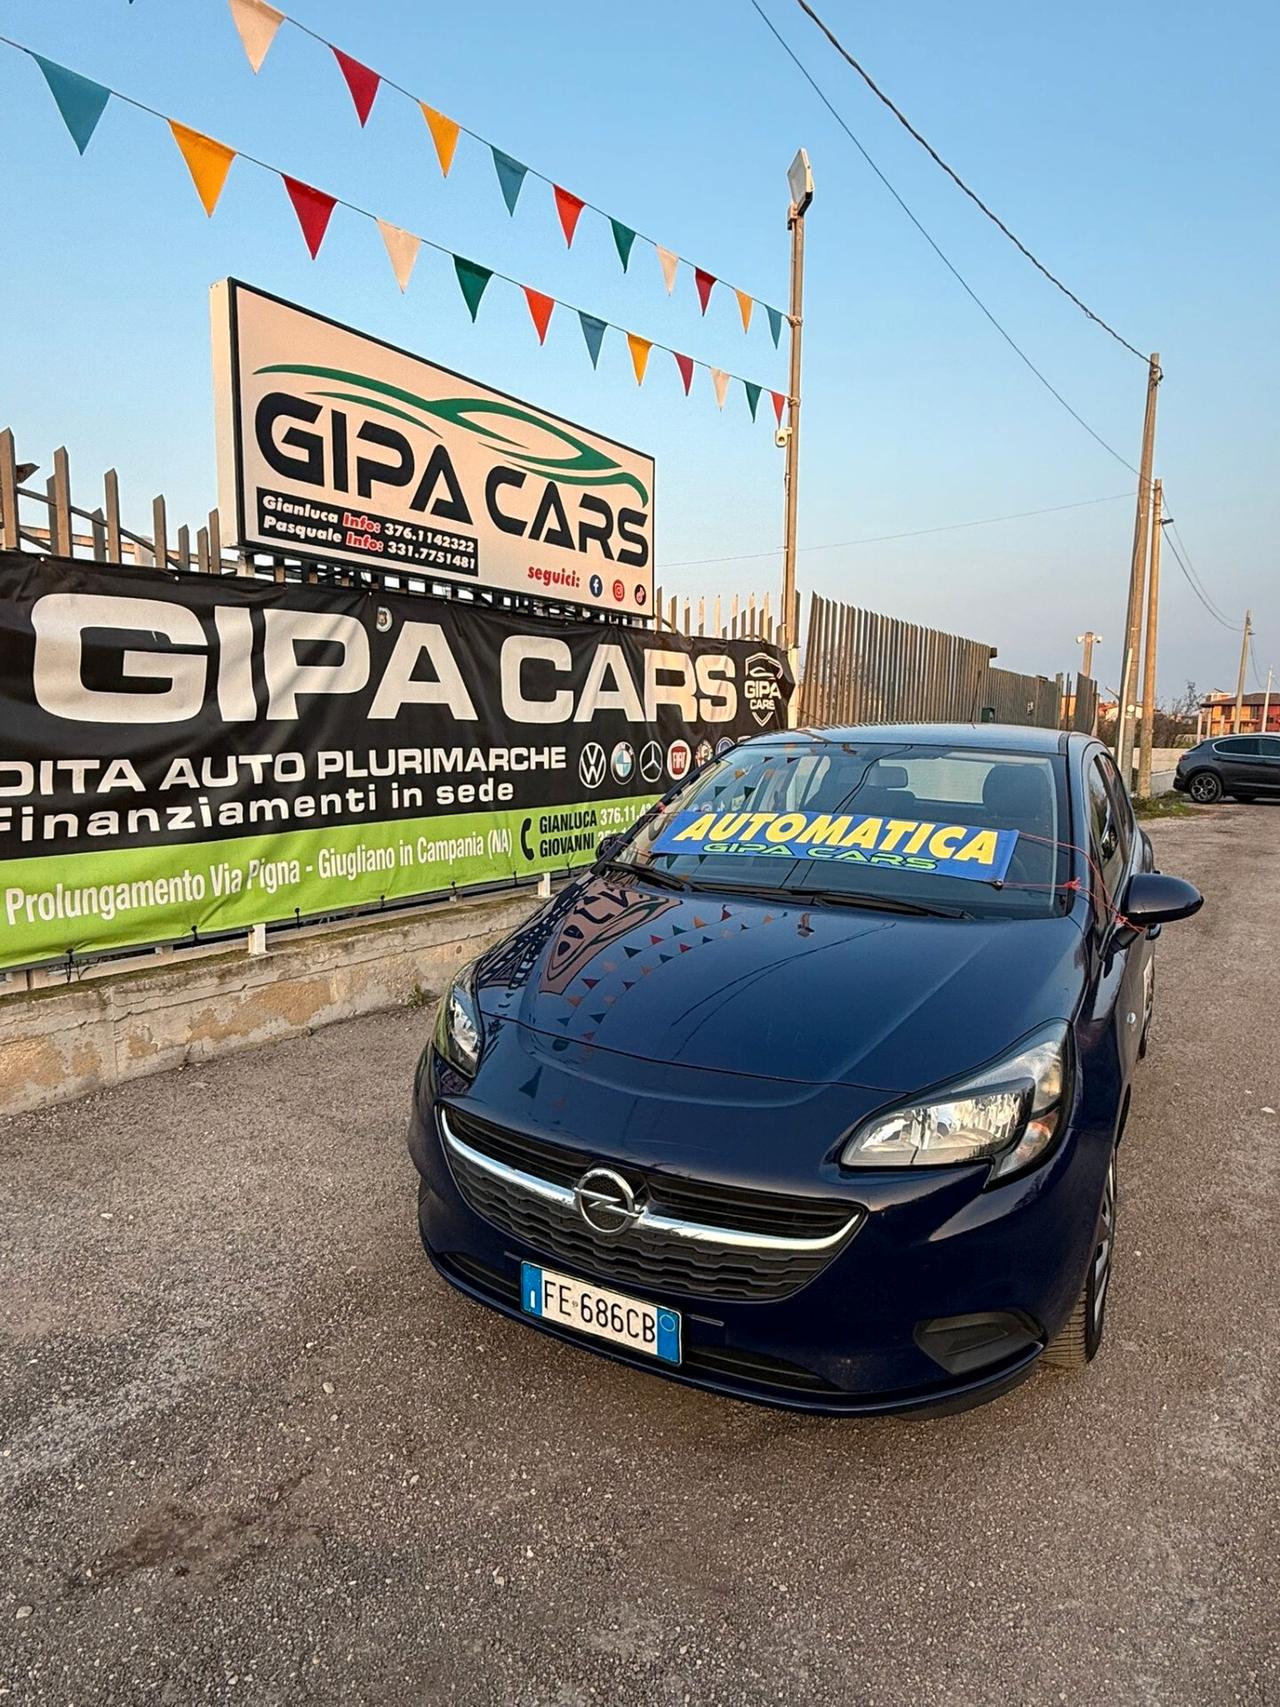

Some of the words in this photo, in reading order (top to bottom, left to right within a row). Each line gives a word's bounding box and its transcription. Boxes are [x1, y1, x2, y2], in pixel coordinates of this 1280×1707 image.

[255, 392, 474, 525] GIPA
[485, 465, 649, 567] CARS
[263, 495, 338, 523] Gianluca
[342, 512, 381, 533] Info:
[384, 522, 475, 553] 376.1142322
[263, 515, 342, 544] Pasquale
[345, 532, 384, 553] Info:
[387, 541, 475, 569] 331.7751481
[527, 566, 581, 588] seguici:
[31, 593, 480, 724] GIPA
[500, 634, 738, 724] CARS
[744, 680, 782, 699] GIPA
[749, 699, 776, 710] CARS
[159, 752, 306, 791] AUTO
[317, 746, 567, 780] PLURIMARCHE
[391, 782, 423, 808] in
[436, 778, 514, 805] sede
[539, 810, 597, 834] GIANLUCA
[672, 813, 998, 865] AUTOMATICA
[539, 832, 594, 857] GIOVANNI
[702, 842, 796, 857] GIPA
[806, 846, 938, 871] CARS
[5, 869, 206, 925] Prolungamento
[209, 863, 242, 897] Via
[246, 858, 300, 894] Pigna
[318, 844, 395, 880] Giugliano
[400, 840, 413, 866] in
[417, 832, 484, 864] Campania
[487, 828, 513, 859] (NA)
